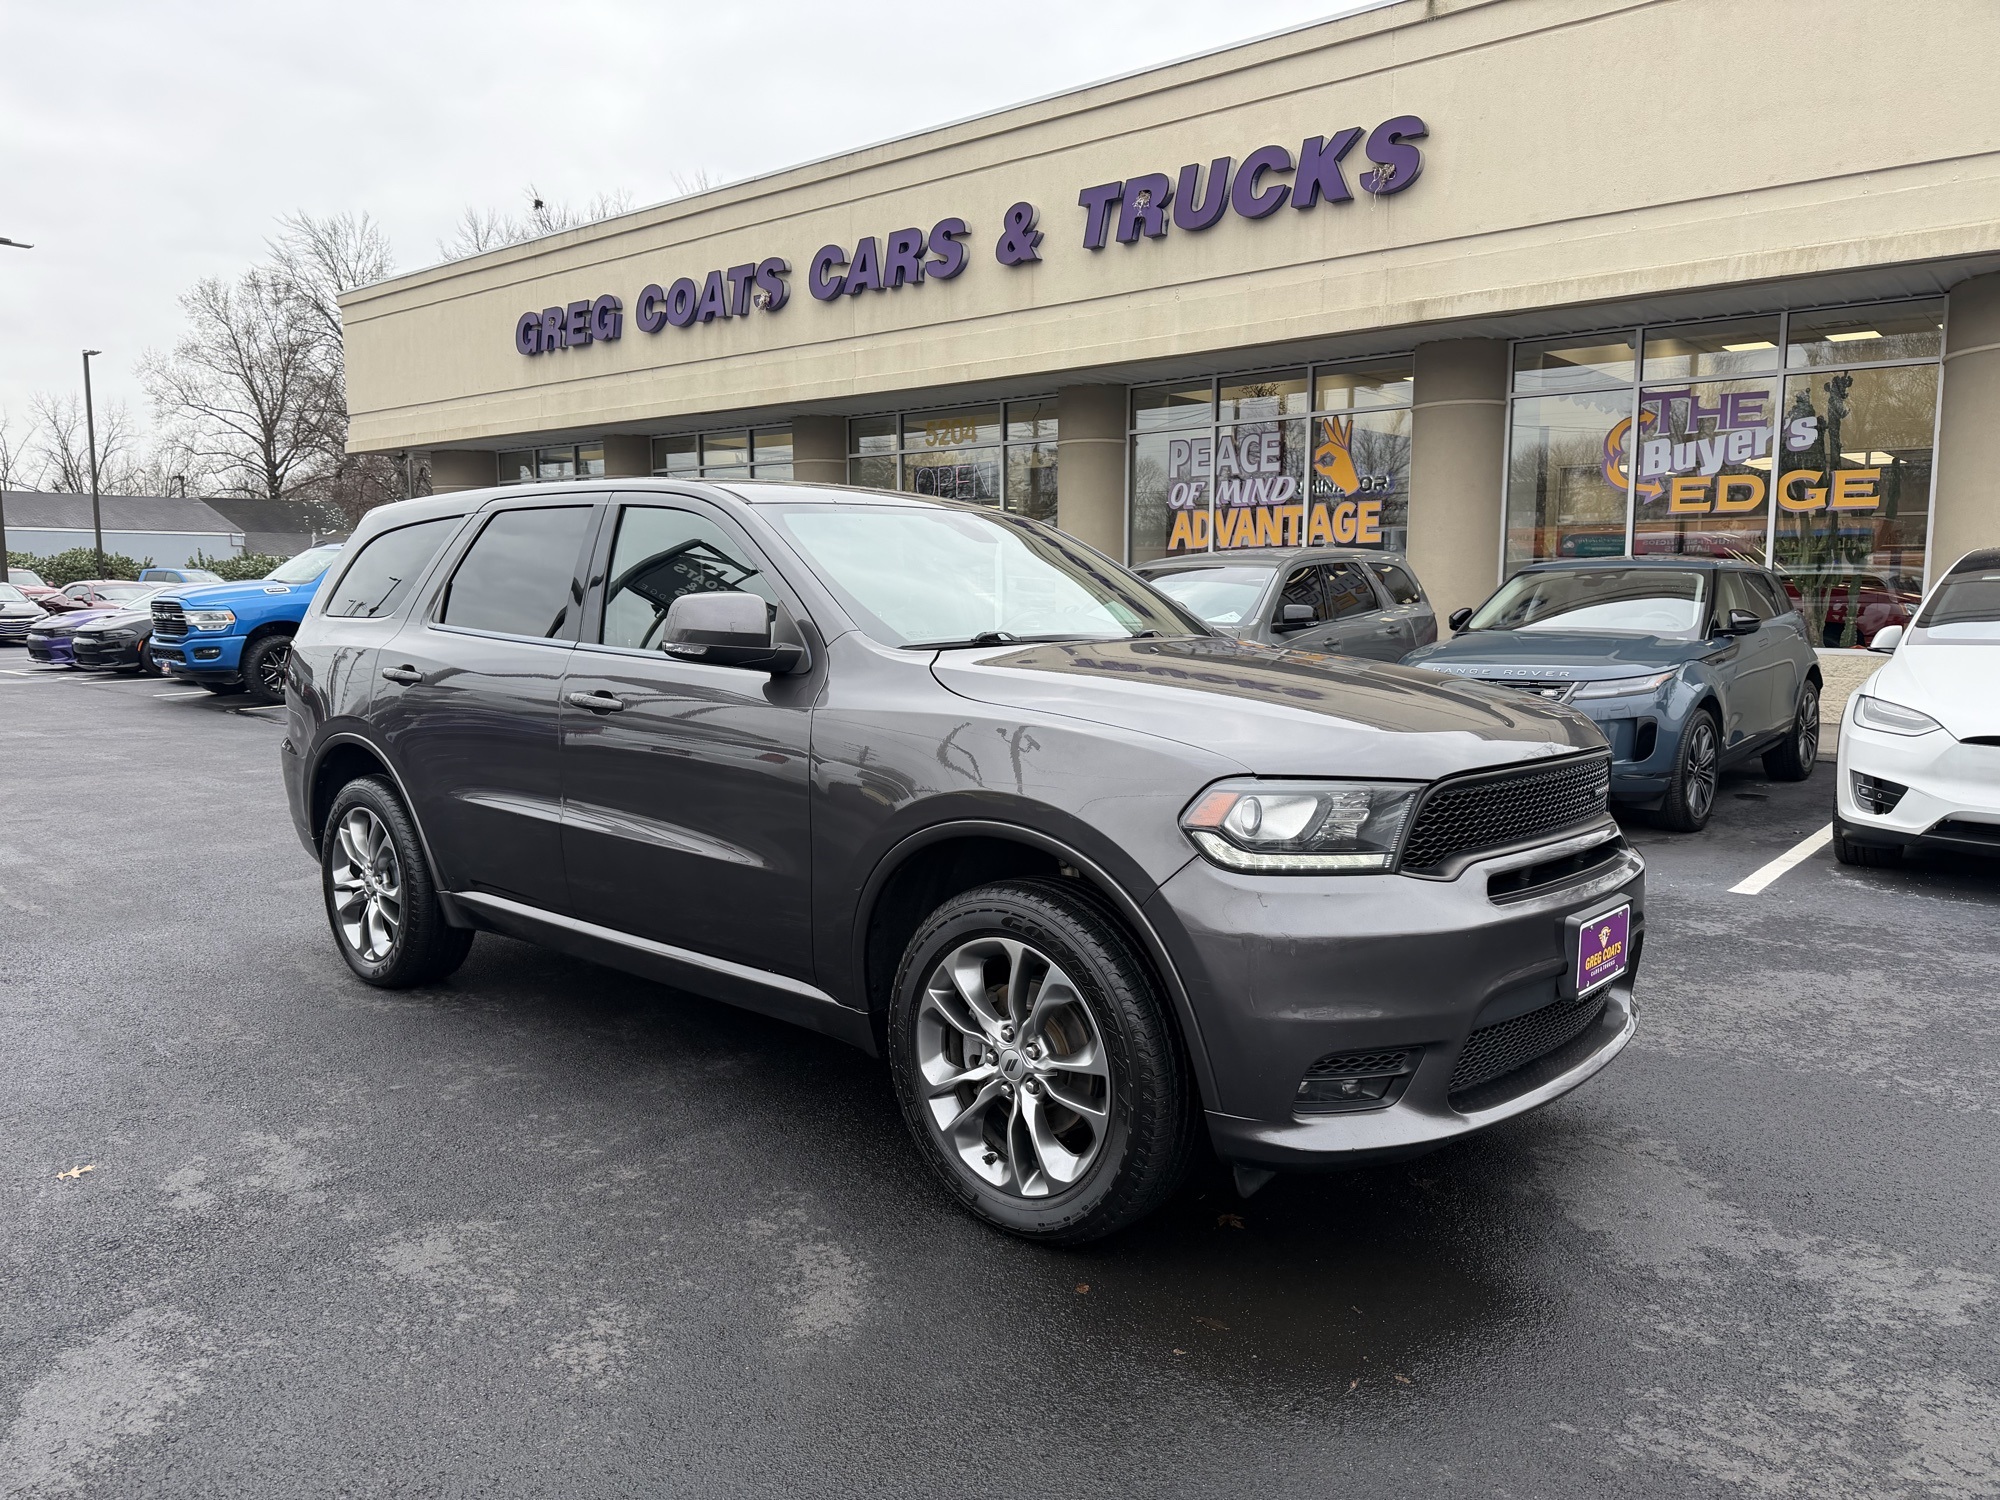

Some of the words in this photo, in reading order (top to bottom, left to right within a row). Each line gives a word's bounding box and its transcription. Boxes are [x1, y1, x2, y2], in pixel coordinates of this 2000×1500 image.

[515, 294, 623, 356] GREG
[635, 257, 792, 334] COATS
[808, 217, 972, 301] CARS
[995, 201, 1043, 267] &
[1078, 114, 1430, 251] TRUCKS
[924, 417, 978, 447] 5204
[1641, 389, 1770, 436] THE
[1168, 431, 1282, 479] PEACE
[1641, 415, 1819, 477] Buyer's
[915, 463, 992, 499] OPEN
[1168, 480, 1206, 510] OF
[1216, 476, 1296, 508] MIND
[1667, 468, 1881, 514] EDGE
[1167, 500, 1382, 550] ADVANTAGE
[1432, 667, 1491, 676] RANGE
[1503, 669, 1570, 677] ROVER
[1585, 952, 1602, 970] GREG
[1603, 941, 1621, 960] COATS
